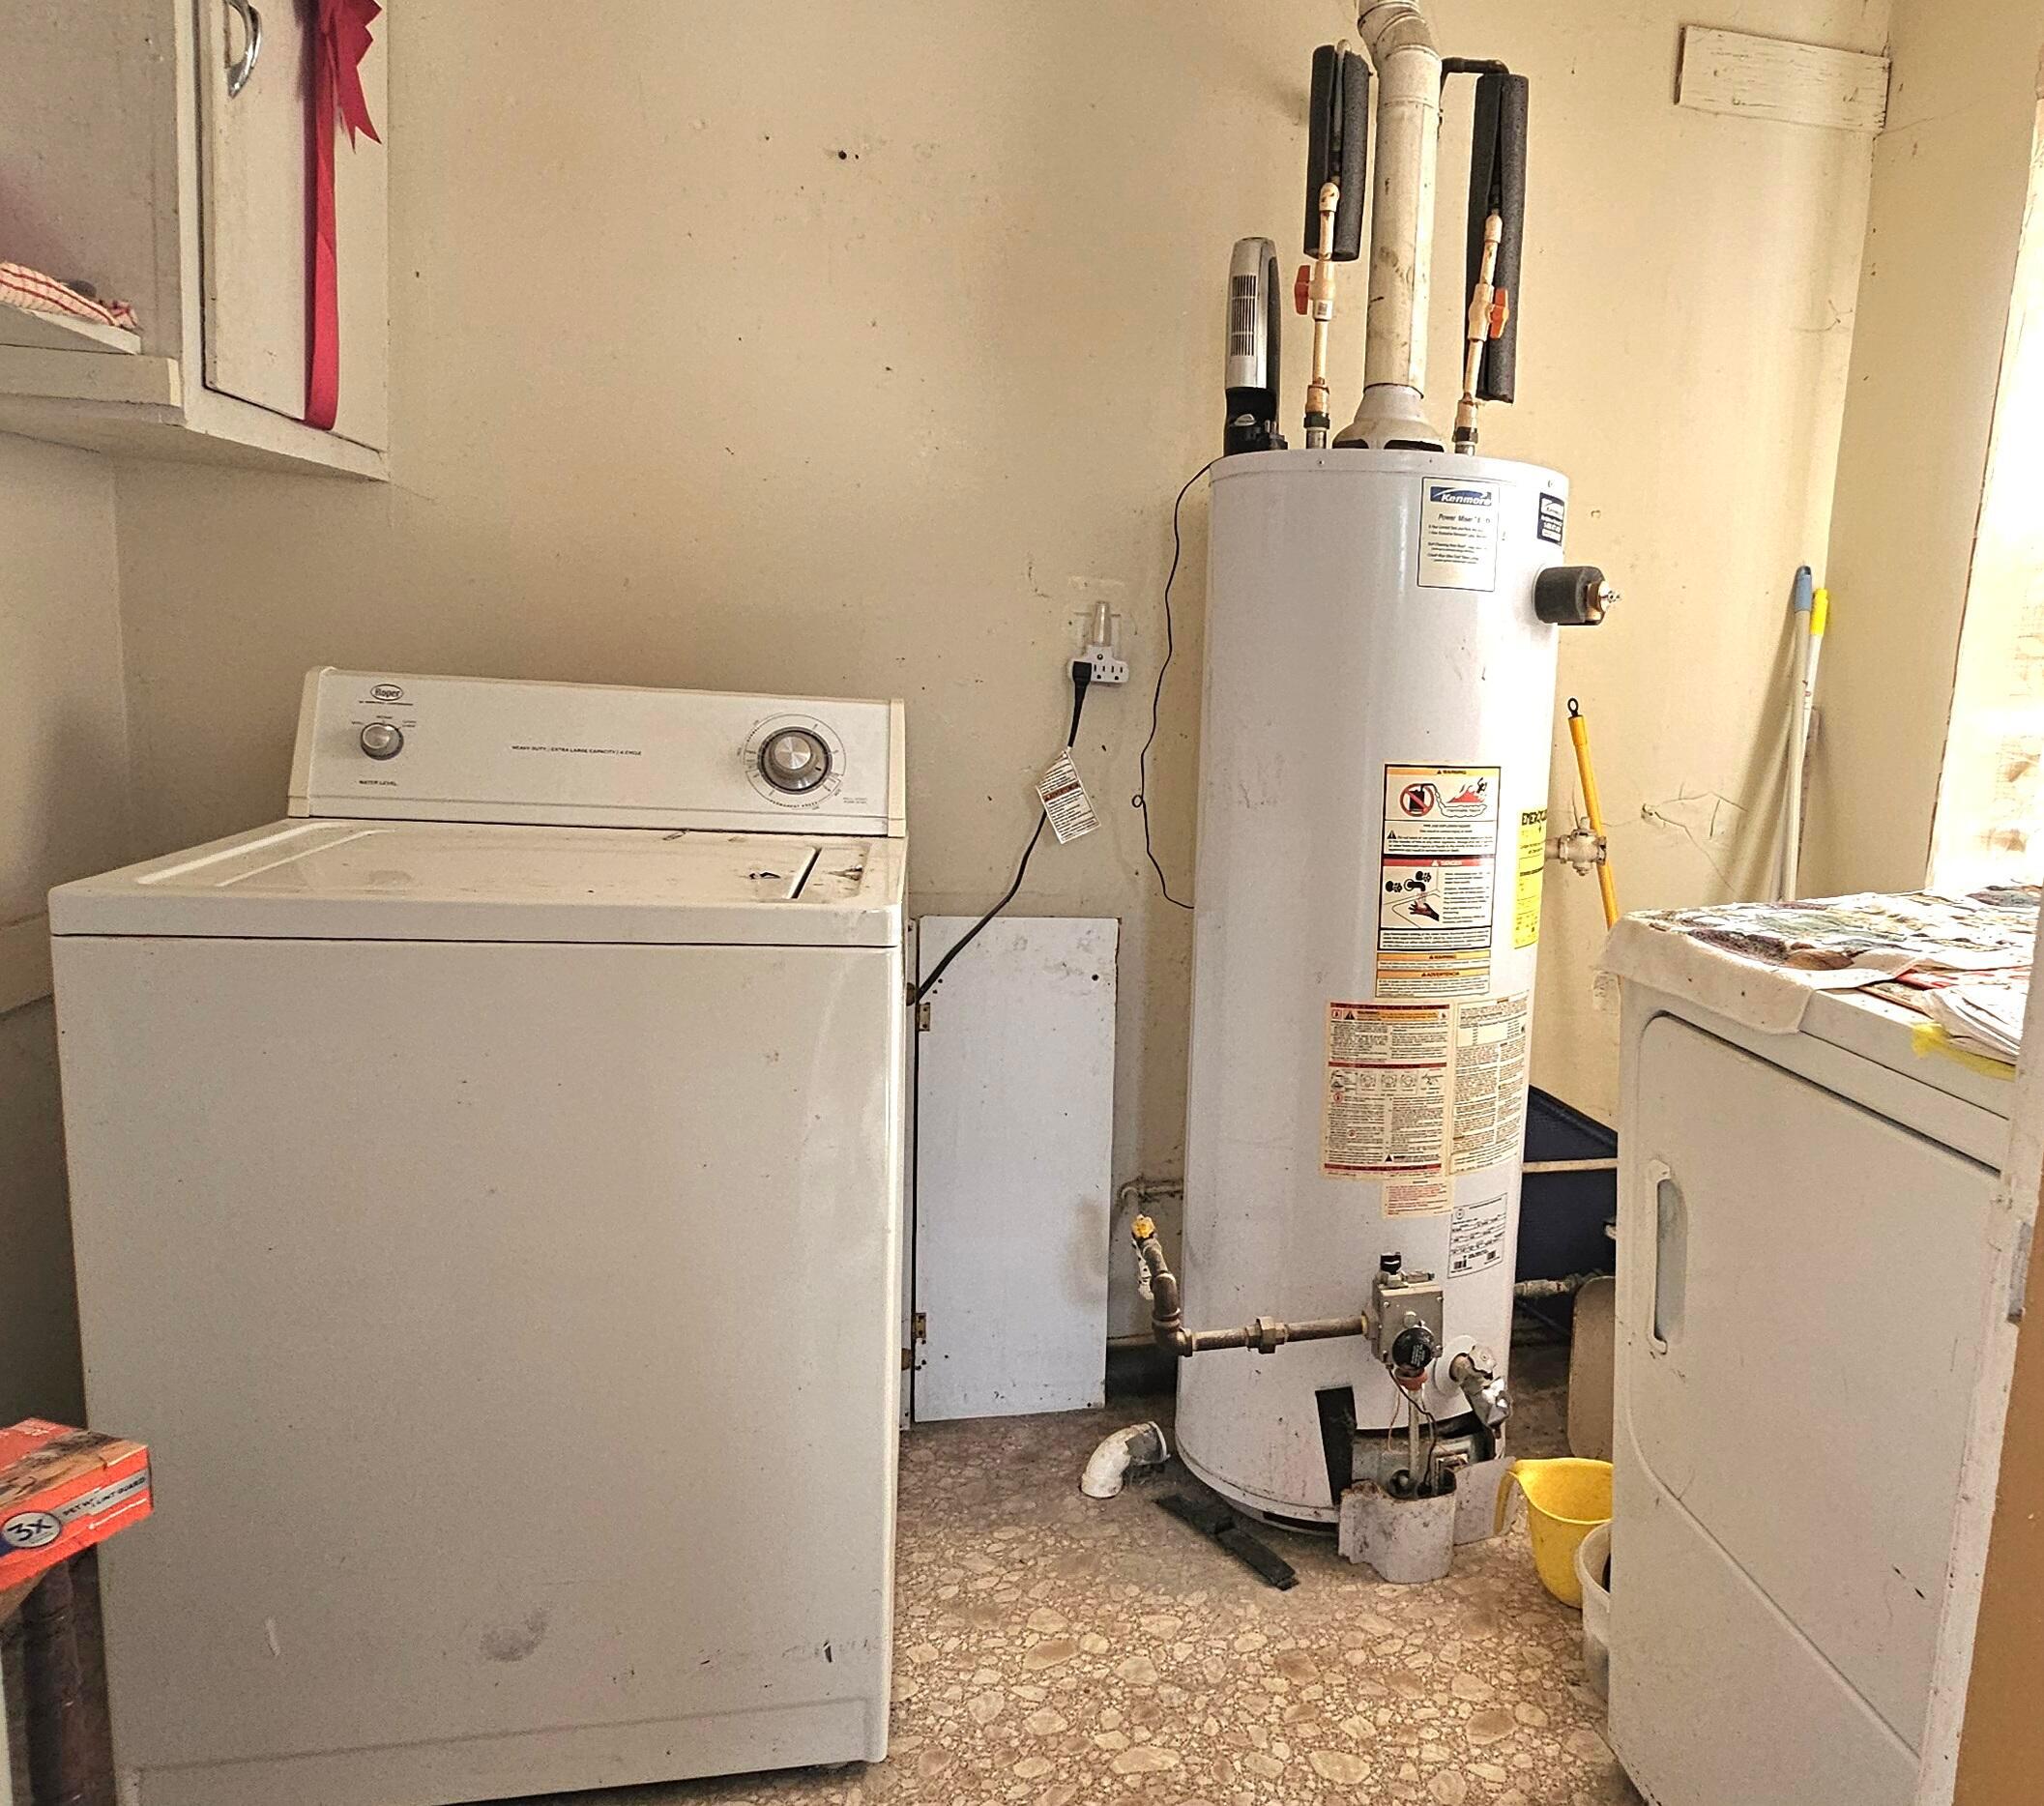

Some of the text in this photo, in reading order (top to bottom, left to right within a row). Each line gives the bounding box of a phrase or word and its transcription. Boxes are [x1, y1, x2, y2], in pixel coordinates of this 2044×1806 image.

[1441, 493, 1491, 506] Kenmore
[7, 552, 54, 575] 3X
[374, 687, 400, 697] Roper
[117, 1476, 146, 1495] GUARD
